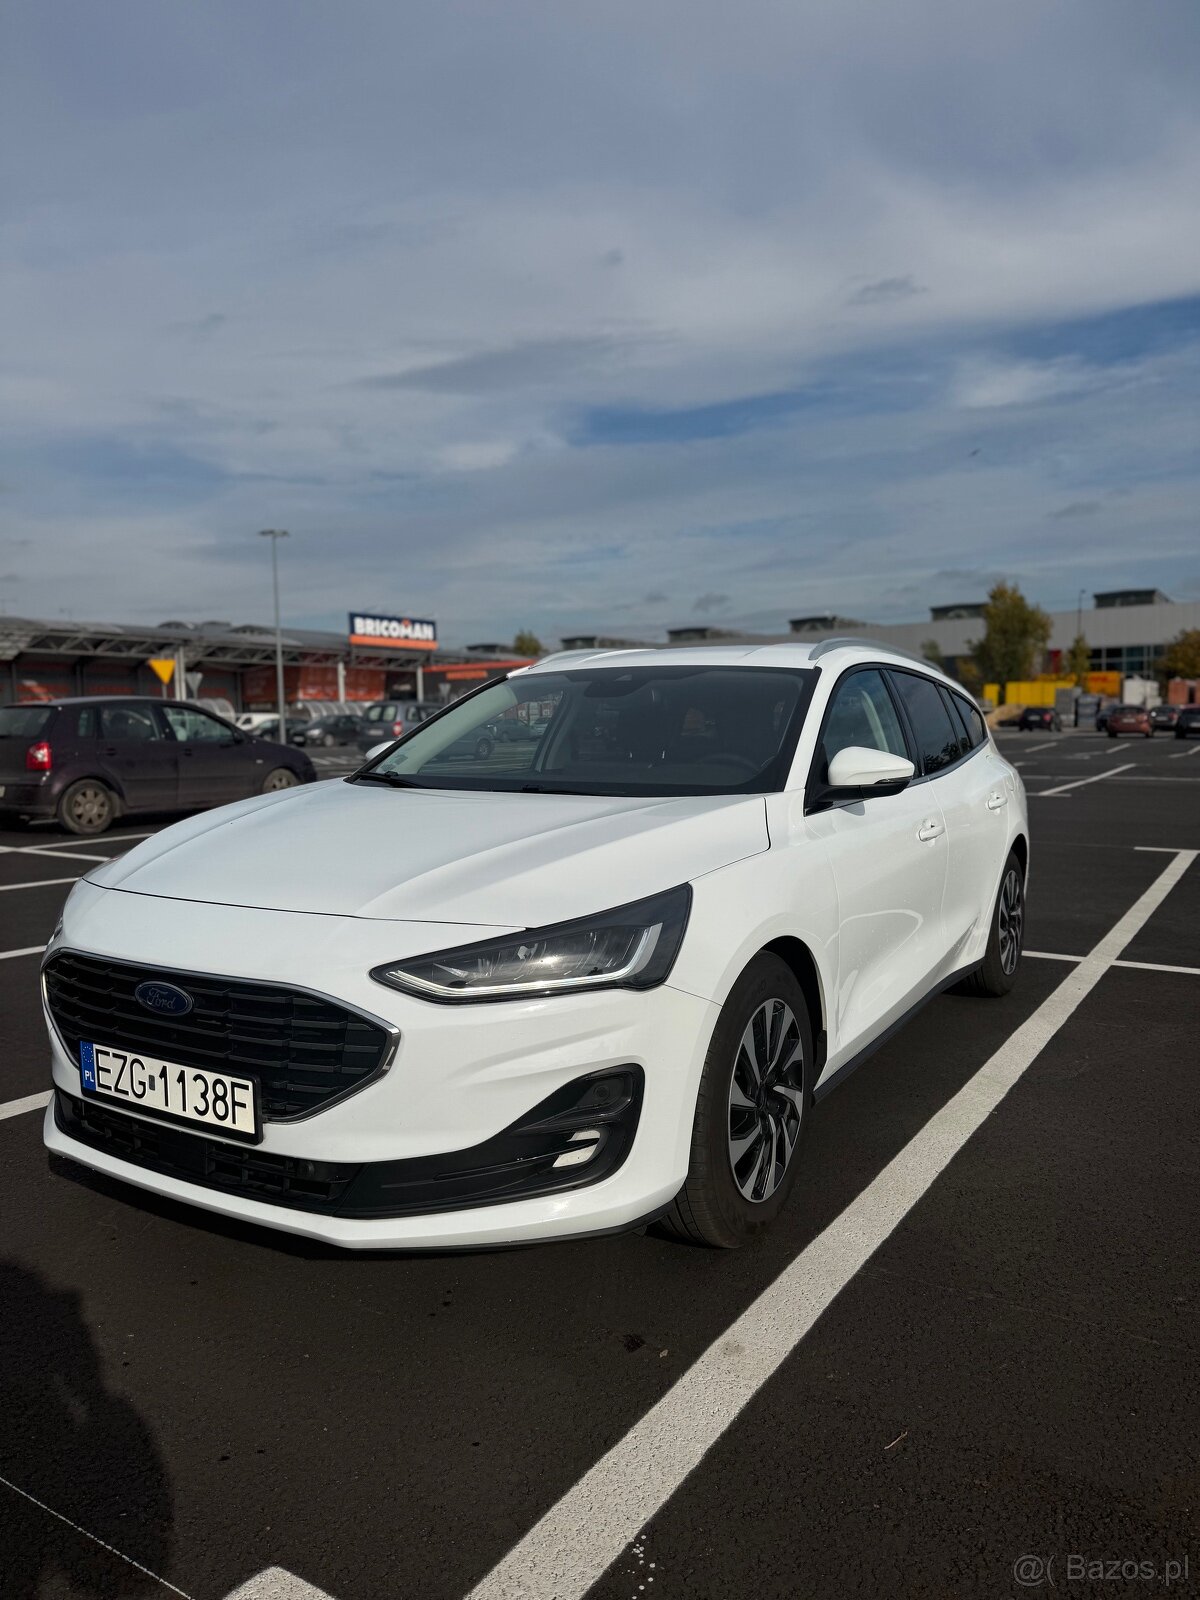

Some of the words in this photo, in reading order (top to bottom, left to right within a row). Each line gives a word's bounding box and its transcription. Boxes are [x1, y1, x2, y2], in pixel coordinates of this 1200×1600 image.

[354, 617, 434, 640] BRICOMAN
[147, 988, 176, 1009] Ford
[85, 1070, 94, 1082] PL
[95, 1048, 146, 1099] EZG
[159, 1065, 250, 1124] 1138F
